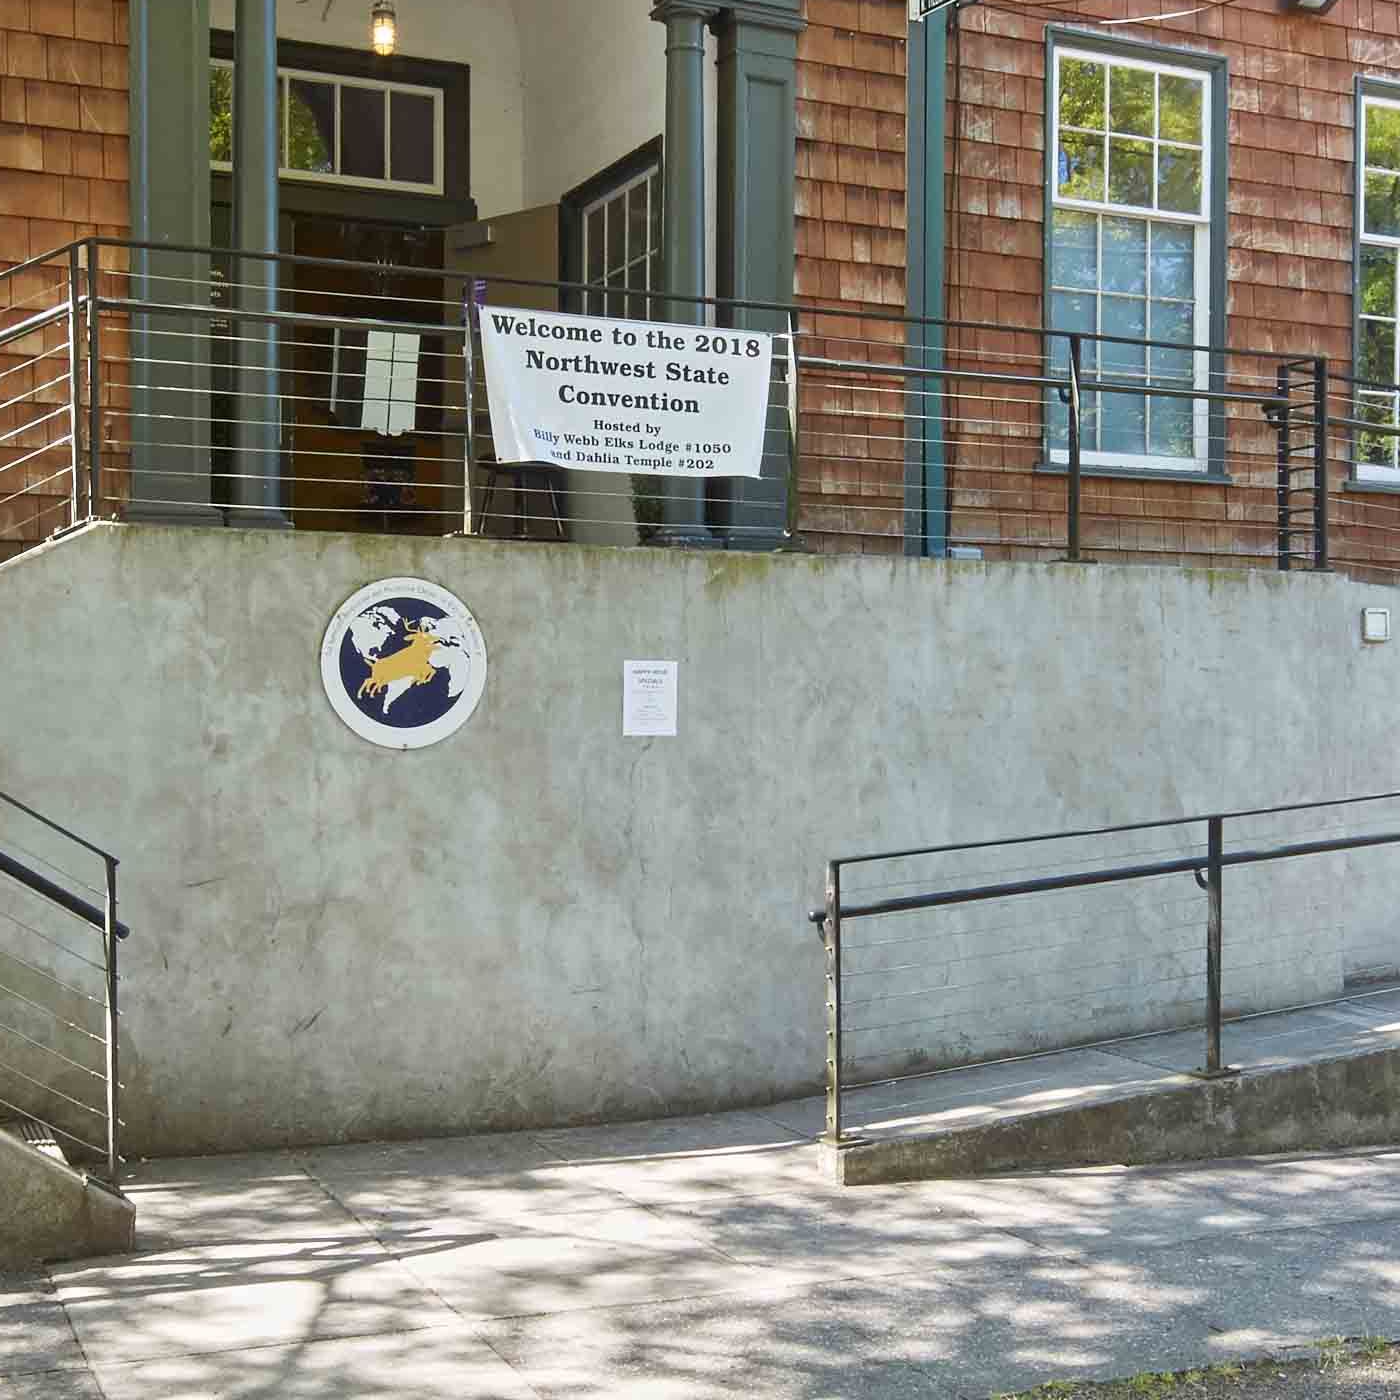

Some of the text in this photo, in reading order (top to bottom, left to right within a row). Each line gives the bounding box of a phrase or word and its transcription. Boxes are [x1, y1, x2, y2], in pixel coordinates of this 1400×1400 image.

[491, 314, 760, 358] Welcome to the 2018
[525, 350, 730, 385] Northwest State
[558, 385, 700, 413] Convention
[533, 428, 731, 454] Billy Webb Elks Lodge #1050
[593, 419, 661, 437] Hosted by
[551, 450, 714, 469] and Dahlia Temple #202
